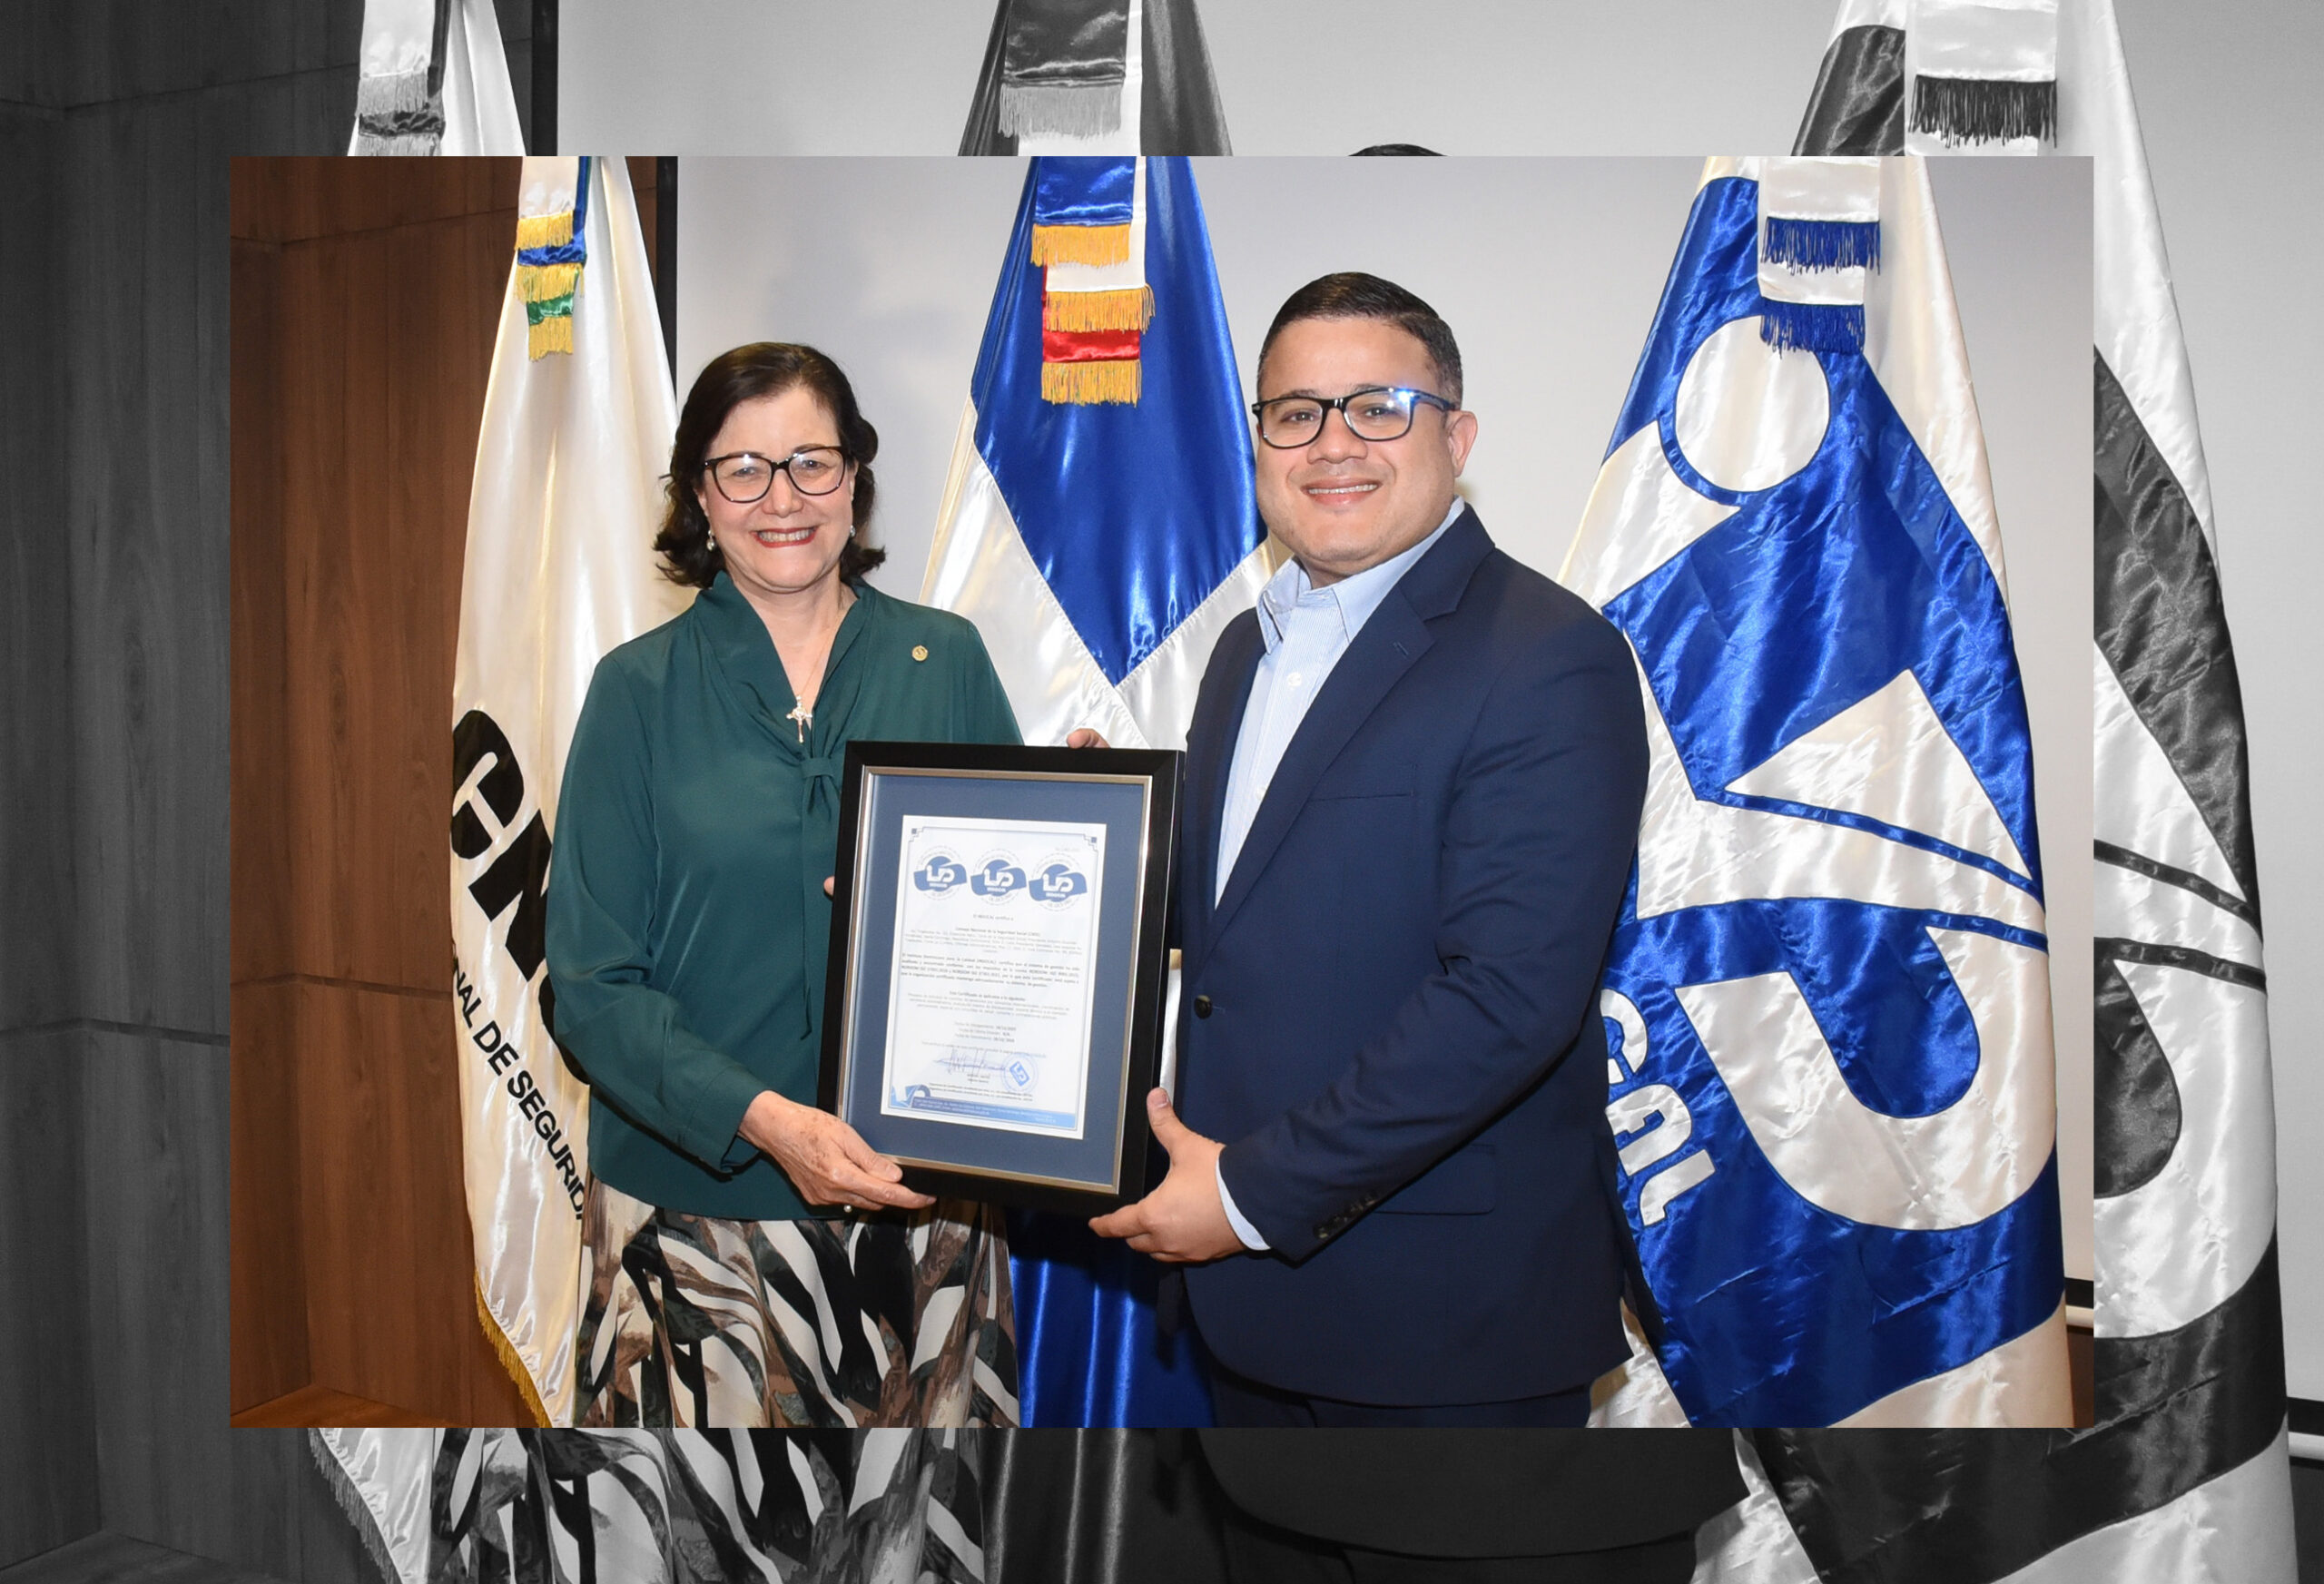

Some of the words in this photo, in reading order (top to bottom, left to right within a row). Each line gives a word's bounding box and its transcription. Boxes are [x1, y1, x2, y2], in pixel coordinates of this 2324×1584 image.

[451, 710, 588, 1085] CN
[473, 1020, 519, 1076] DE
[507, 1070, 585, 1220] SEGURID
